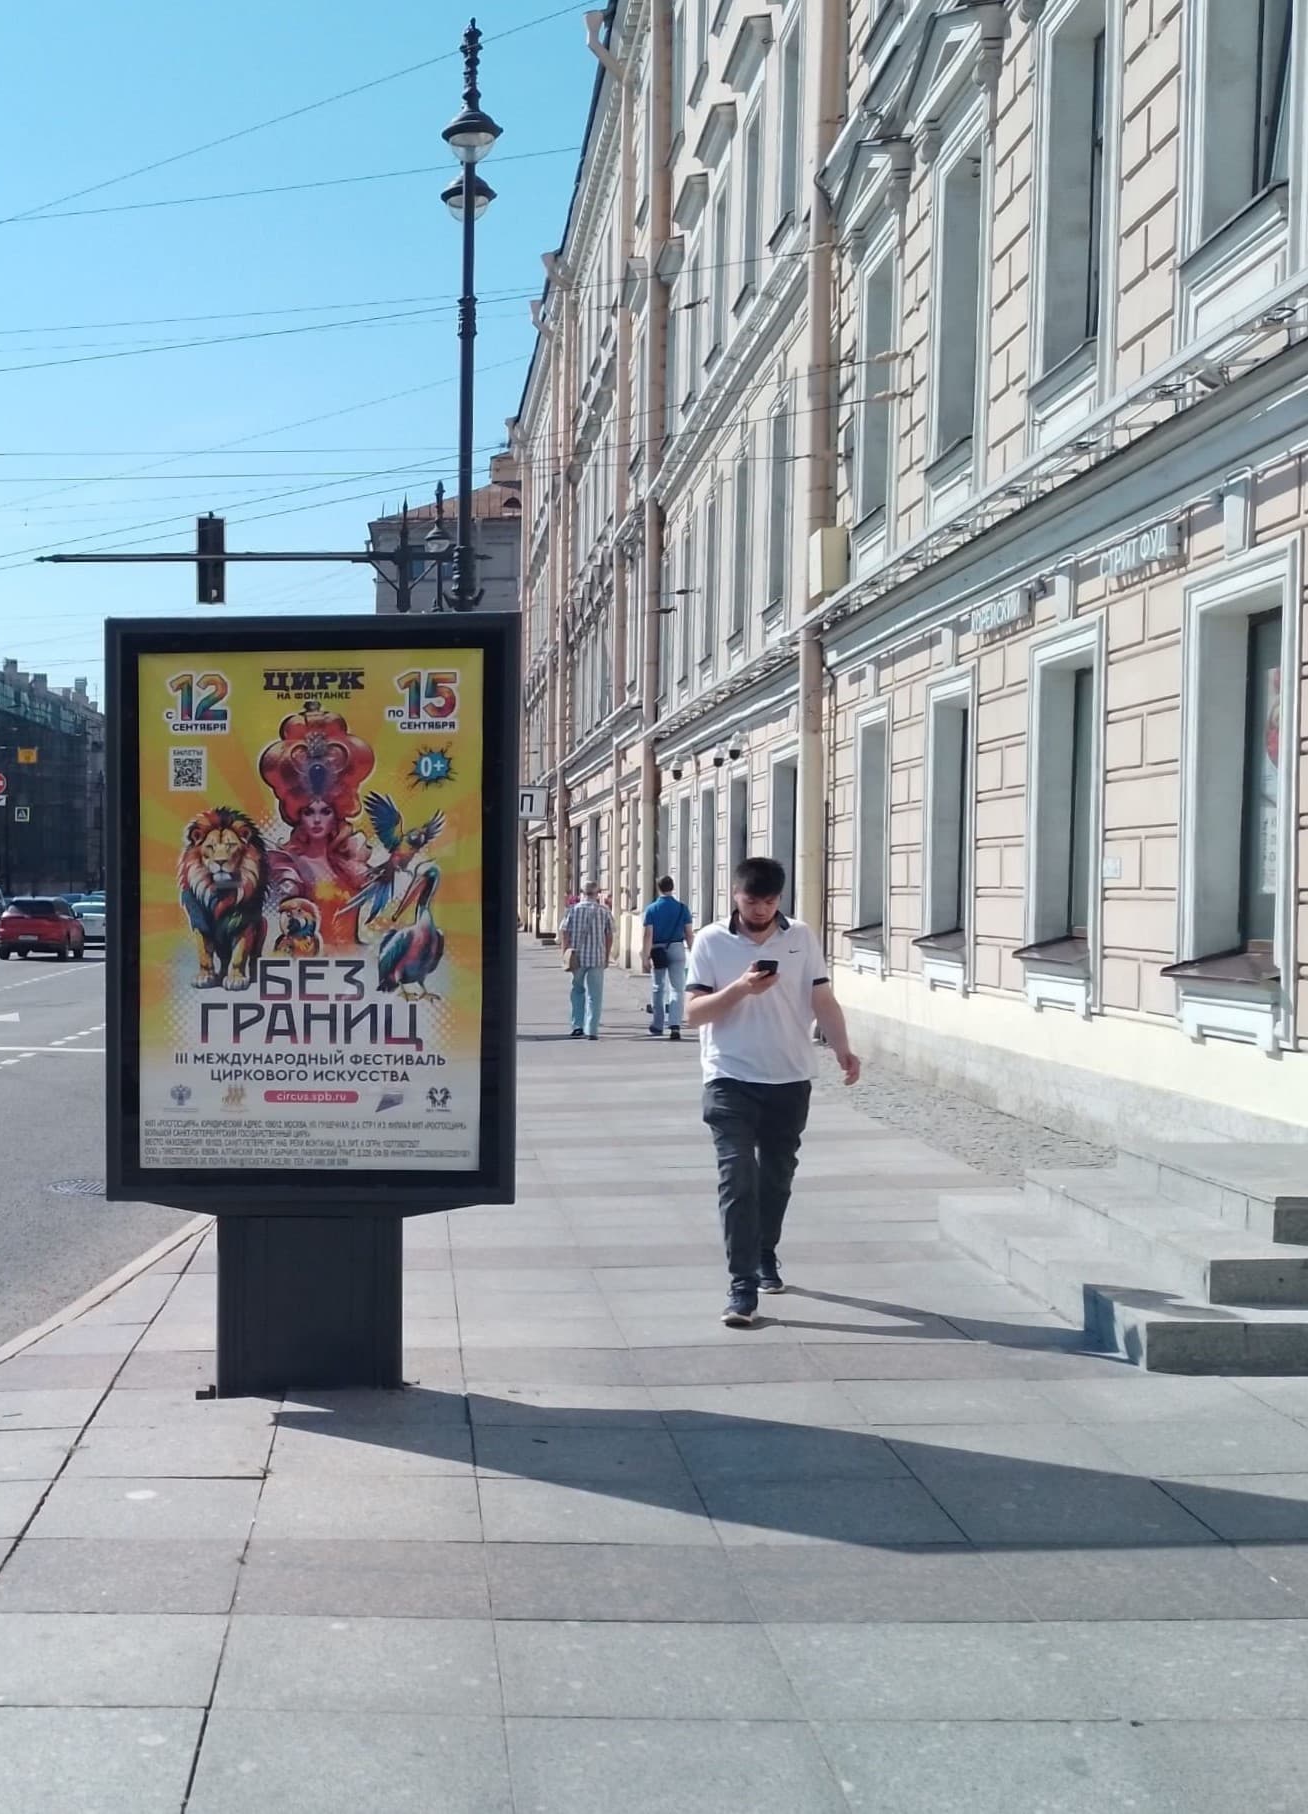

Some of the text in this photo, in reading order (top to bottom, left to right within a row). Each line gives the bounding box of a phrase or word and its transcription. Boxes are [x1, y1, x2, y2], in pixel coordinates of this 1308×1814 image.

[1100, 524, 1168, 578] СТРИТ ФУД
[263, 671, 365, 691] ЦИРК
[169, 673, 228, 721] 12
[277, 691, 351, 700] НА ФОНТАНКЕ
[397, 671, 457, 719] 15
[172, 722, 227, 732] СЕНТЯБРЯ
[400, 721, 456, 730] СЕНТЯБРЯ
[420, 757, 445, 777] 0+
[259, 960, 365, 1001] БЕЗ
[200, 1003, 424, 1051] ГРАНИЦ
[174, 1050, 446, 1068] III МЕЖДУНАРОДНЫЙ ФЕСТИВАЛЬ
[210, 1069, 410, 1084] ЦИРКОВОГО ИСКУССТВА
[276, 1090, 347, 1102] circus.spb.ru
